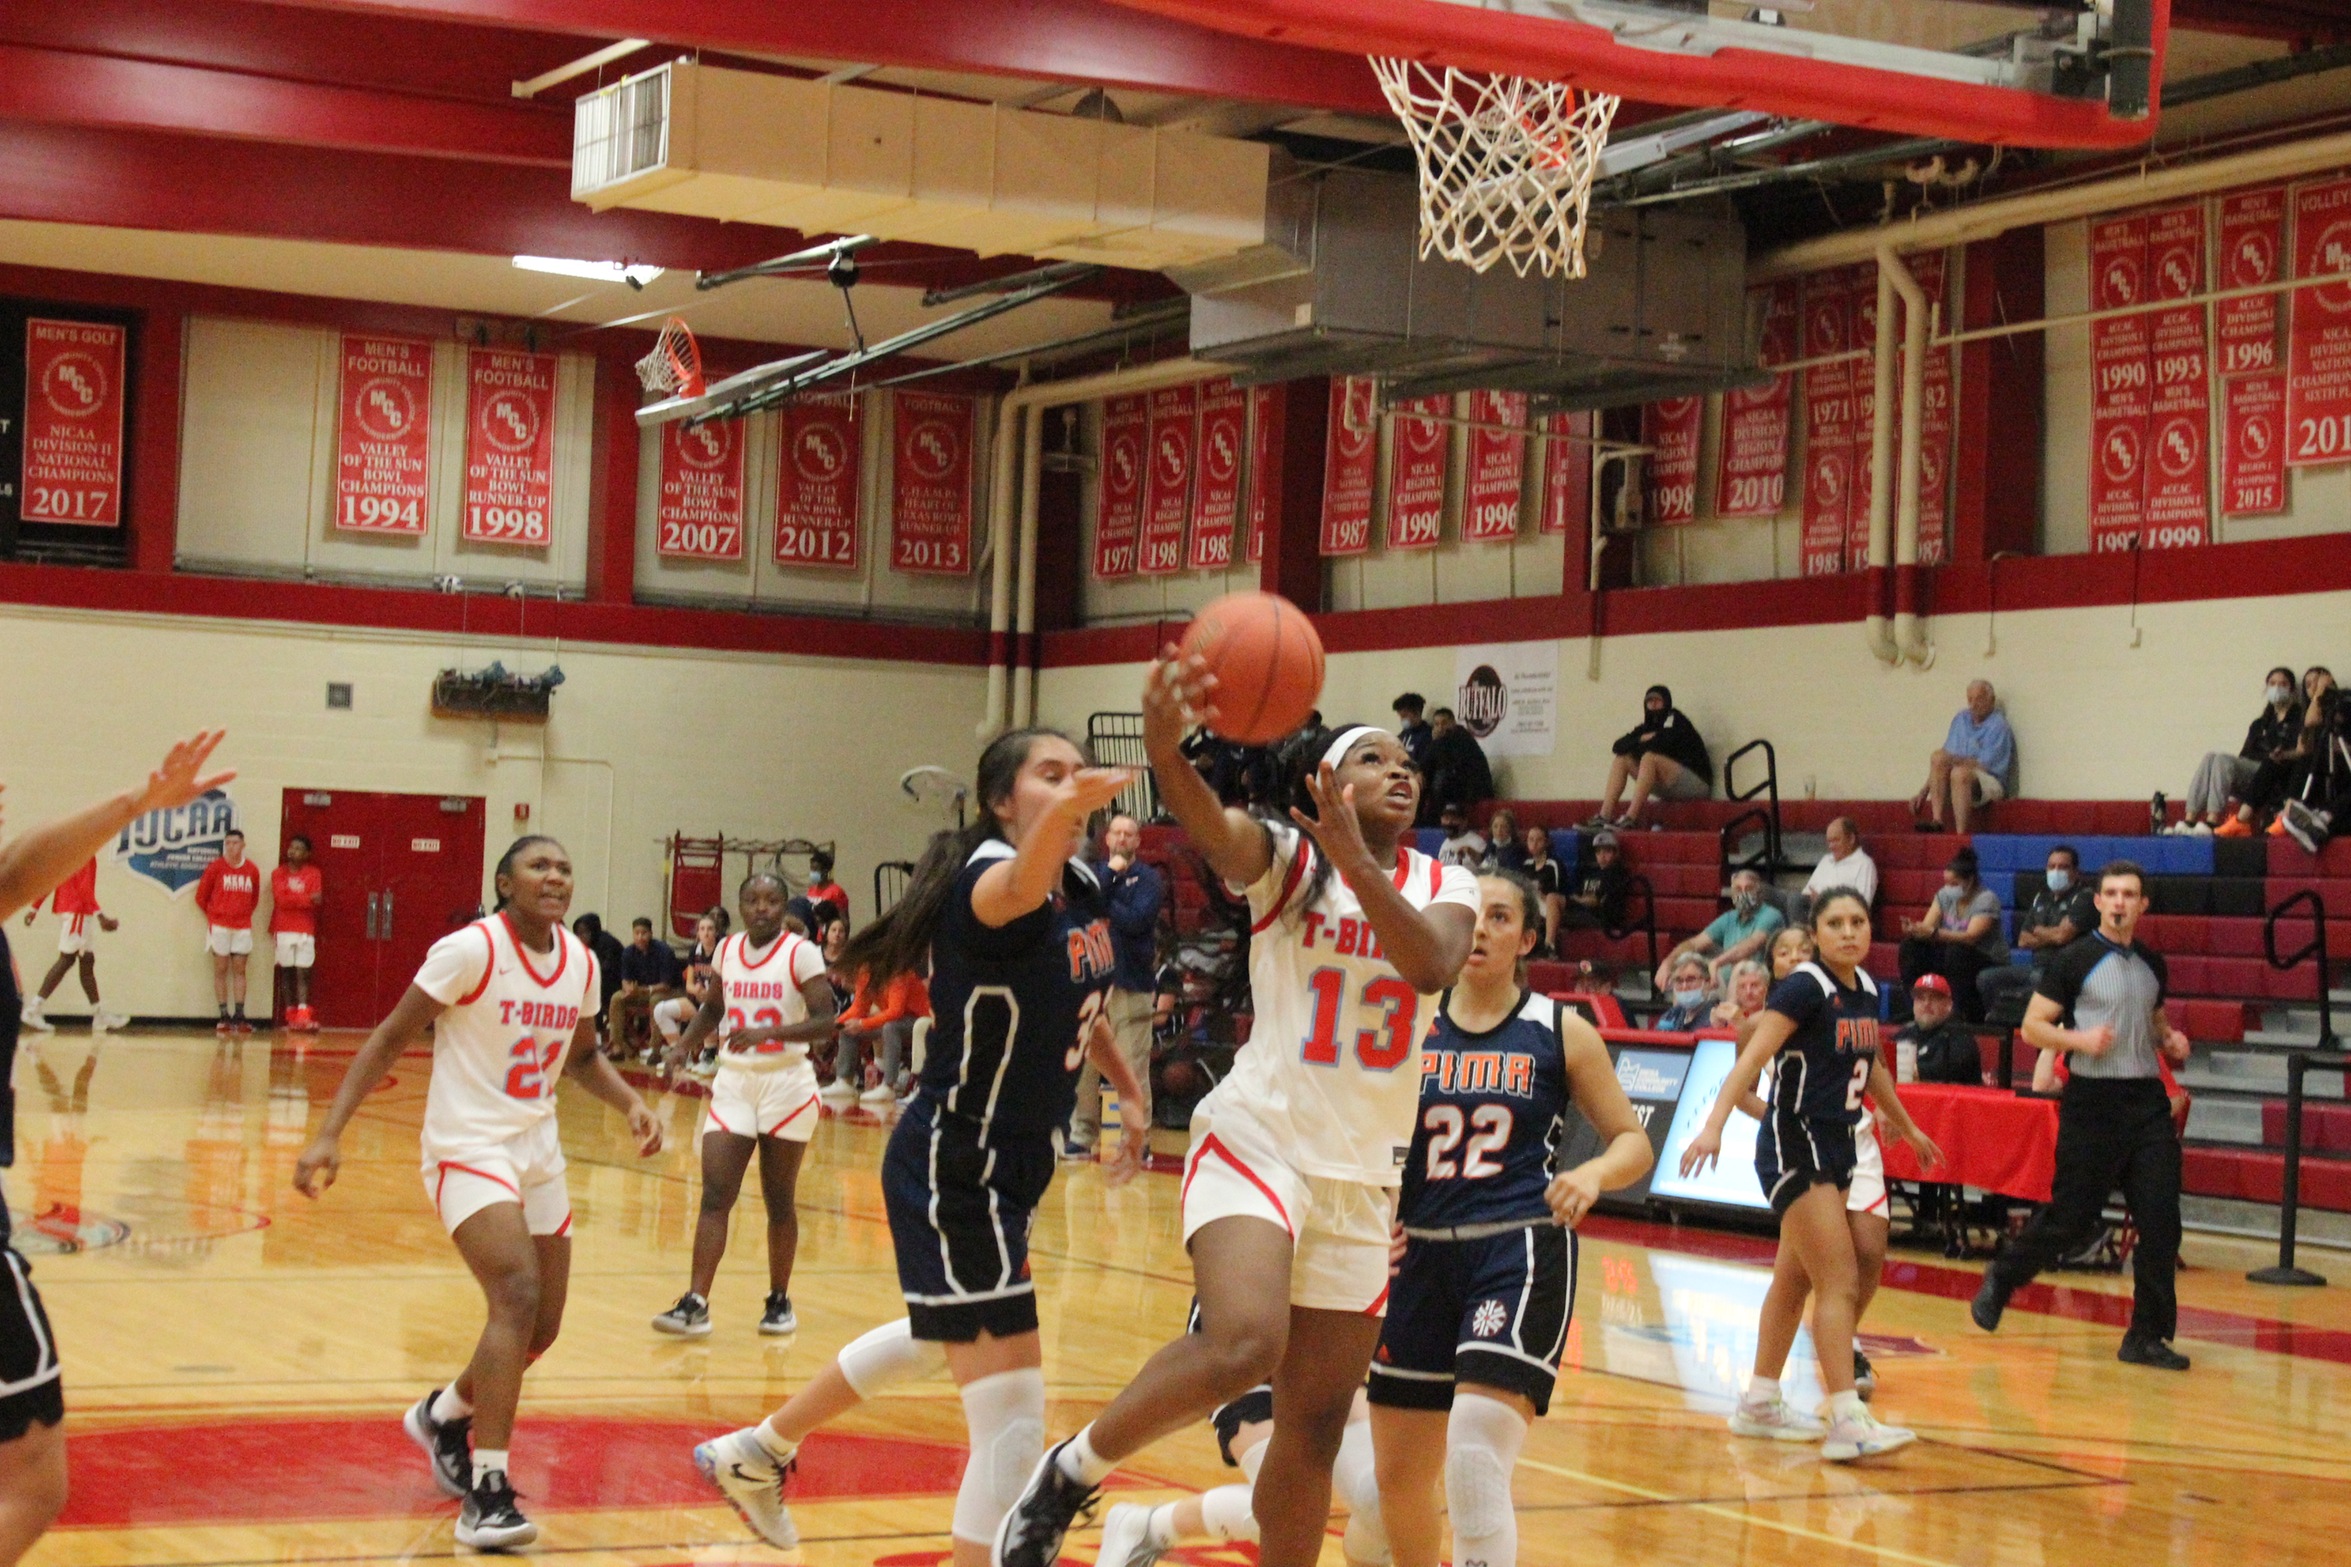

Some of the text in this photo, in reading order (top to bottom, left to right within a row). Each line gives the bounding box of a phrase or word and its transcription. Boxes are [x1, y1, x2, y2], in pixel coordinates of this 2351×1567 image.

[2301, 190, 2351, 212] VOLLEY
[36, 326, 117, 345] MEN'S GOLF
[364, 341, 409, 359] MEN'S
[2226, 339, 2273, 371] 1996
[349, 356, 424, 377] FOOTBALL
[491, 355, 534, 372] MEN'S
[2155, 353, 2201, 384] 1993
[474, 369, 549, 390] FOOTBALL
[2102, 361, 2146, 391] 1990
[1814, 399, 1849, 424] 1971
[50, 425, 95, 440] NJCAA
[33, 438, 97, 454] DIVISION
[359, 442, 408, 457] VALLEY
[36, 452, 107, 468] NATIONAL
[343, 454, 422, 472] OF THE SUN
[485, 452, 532, 468] VALLEY
[28, 467, 114, 483] CHAMPIONS
[363, 468, 402, 482] BOWL
[469, 465, 546, 484] OF THE SUN
[680, 469, 725, 485] VALLEY
[341, 479, 424, 498] CHAMPIONS
[488, 479, 527, 494] BOWL
[664, 481, 737, 499] OF THE SUN
[1729, 473, 1784, 509] 2010
[2236, 485, 2273, 509] 2015
[32, 487, 109, 519] 2017
[469, 490, 546, 509] RUNNER-UP
[682, 496, 719, 510] BOWL
[1651, 483, 1694, 517] 1998
[343, 494, 420, 529] 1994
[469, 505, 544, 539] 1998
[662, 506, 739, 524] CHAMPIONS
[1474, 502, 1518, 534] 1996
[663, 521, 736, 554] 2007
[1330, 517, 1370, 548] 1987
[1400, 510, 1440, 543] 1990
[779, 526, 851, 560] 2012
[2147, 526, 2201, 551] 1999
[899, 538, 961, 568] 2013
[1302, 912, 1385, 959] T-BI
[500, 1000, 578, 1030] T-BIRDS
[1300, 965, 1419, 1073] 13
[1421, 1050, 1535, 1099] PIMA
[1424, 1104, 1514, 1180] 22
